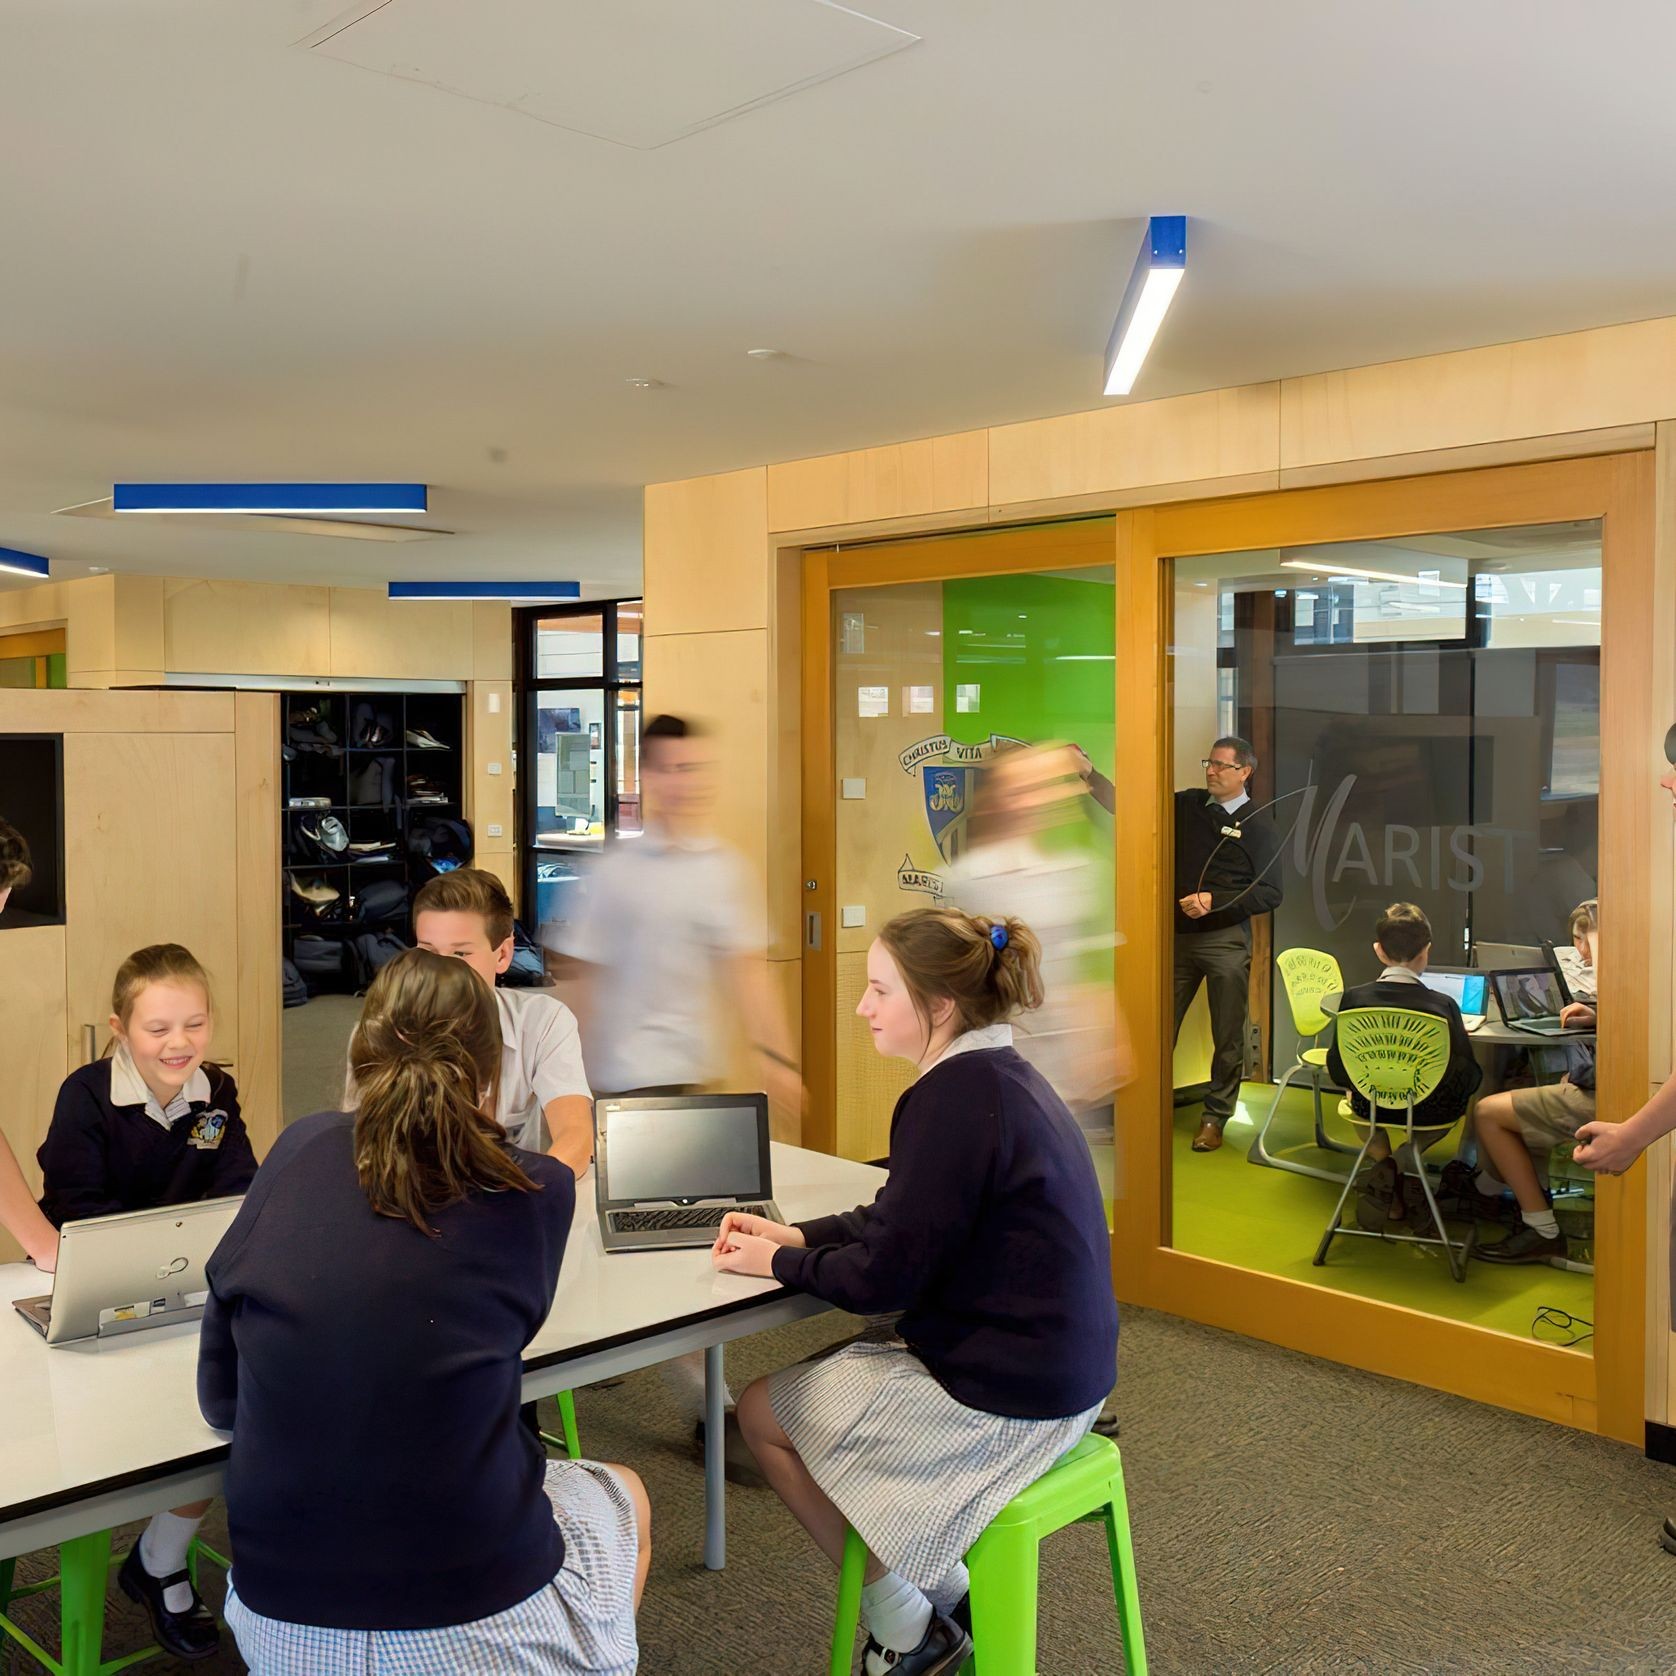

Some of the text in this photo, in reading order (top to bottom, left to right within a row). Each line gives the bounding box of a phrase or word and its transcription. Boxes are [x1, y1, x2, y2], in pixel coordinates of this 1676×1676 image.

[902, 739, 983, 766] CHRISTUS VITA
[1197, 759, 1535, 932] MARIST
